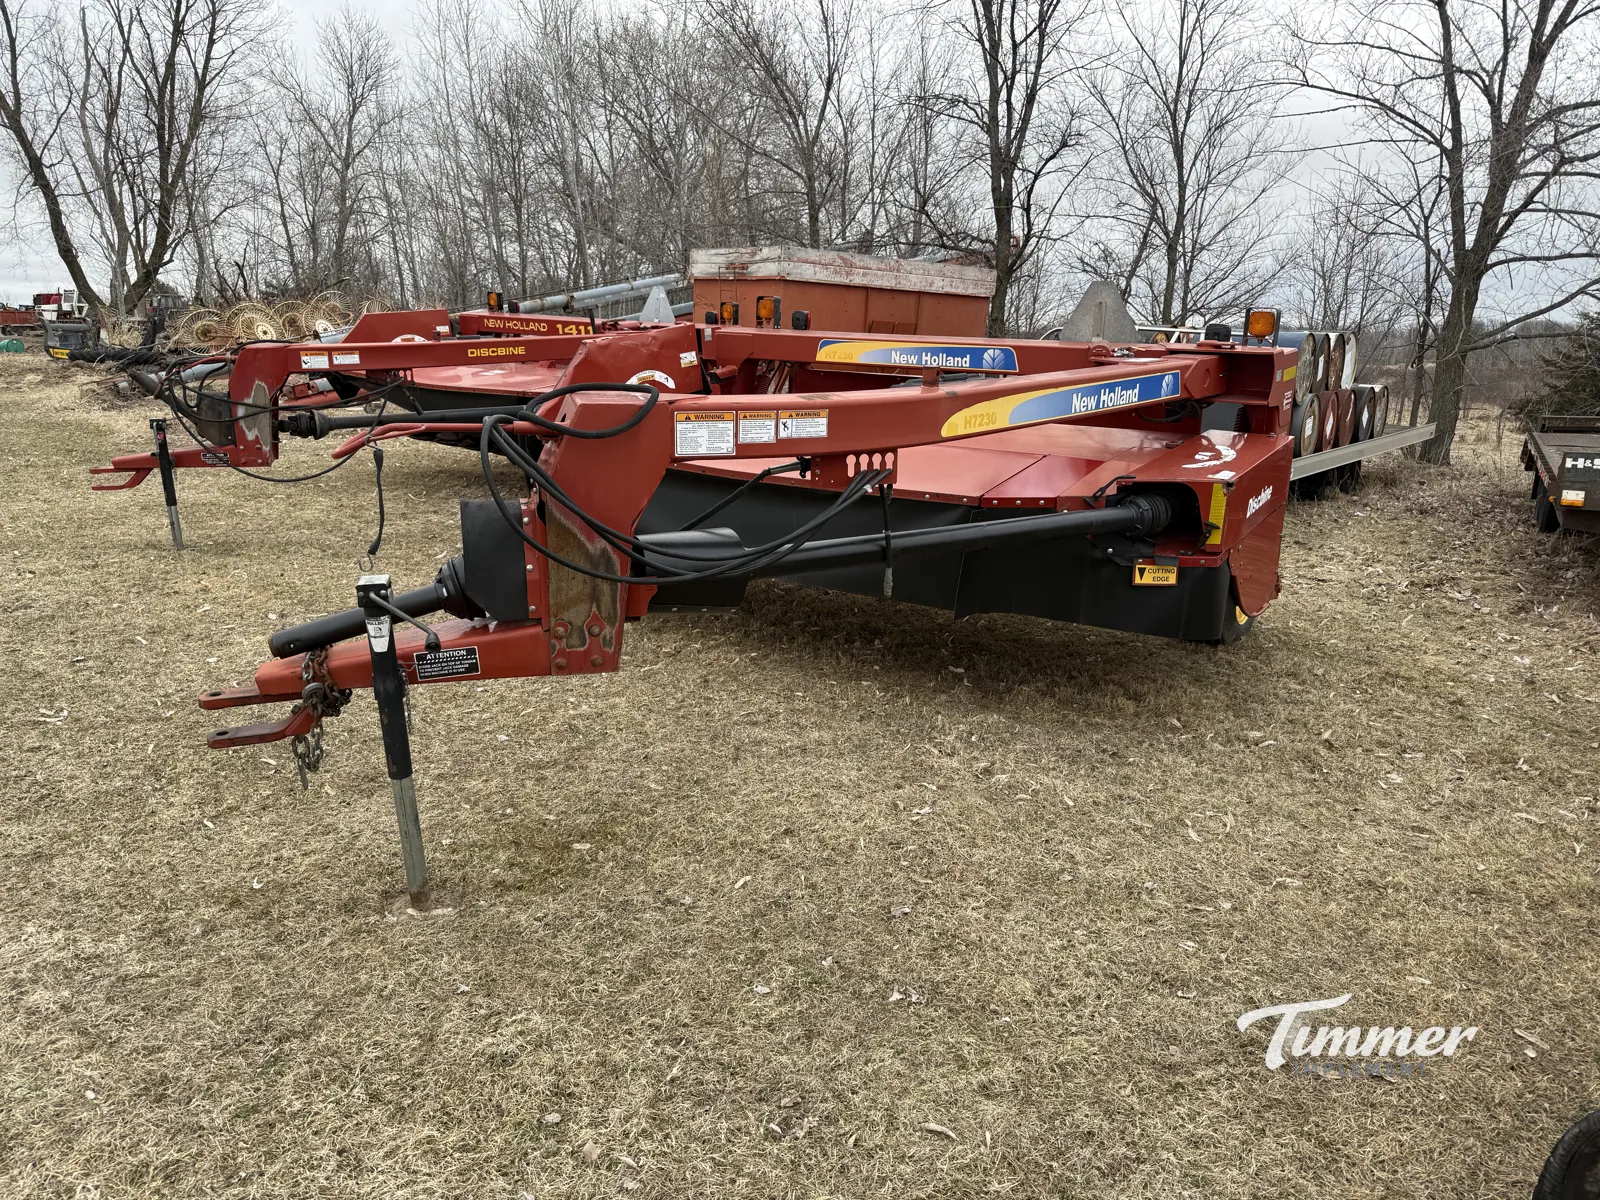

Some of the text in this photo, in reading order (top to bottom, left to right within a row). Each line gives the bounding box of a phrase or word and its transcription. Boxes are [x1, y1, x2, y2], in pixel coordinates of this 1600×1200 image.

[484, 319, 548, 332] NEW HOLLAND
[556, 323, 594, 335] 1411
[467, 346, 526, 357] DISCBINE
[891, 350, 970, 368] New Holland
[1071, 383, 1140, 414] New Holland
[963, 411, 997, 431] H7230
[1246, 485, 1272, 518] Discbine
[1147, 567, 1176, 575] CUTTING
[426, 650, 466, 660] ATTENTION
